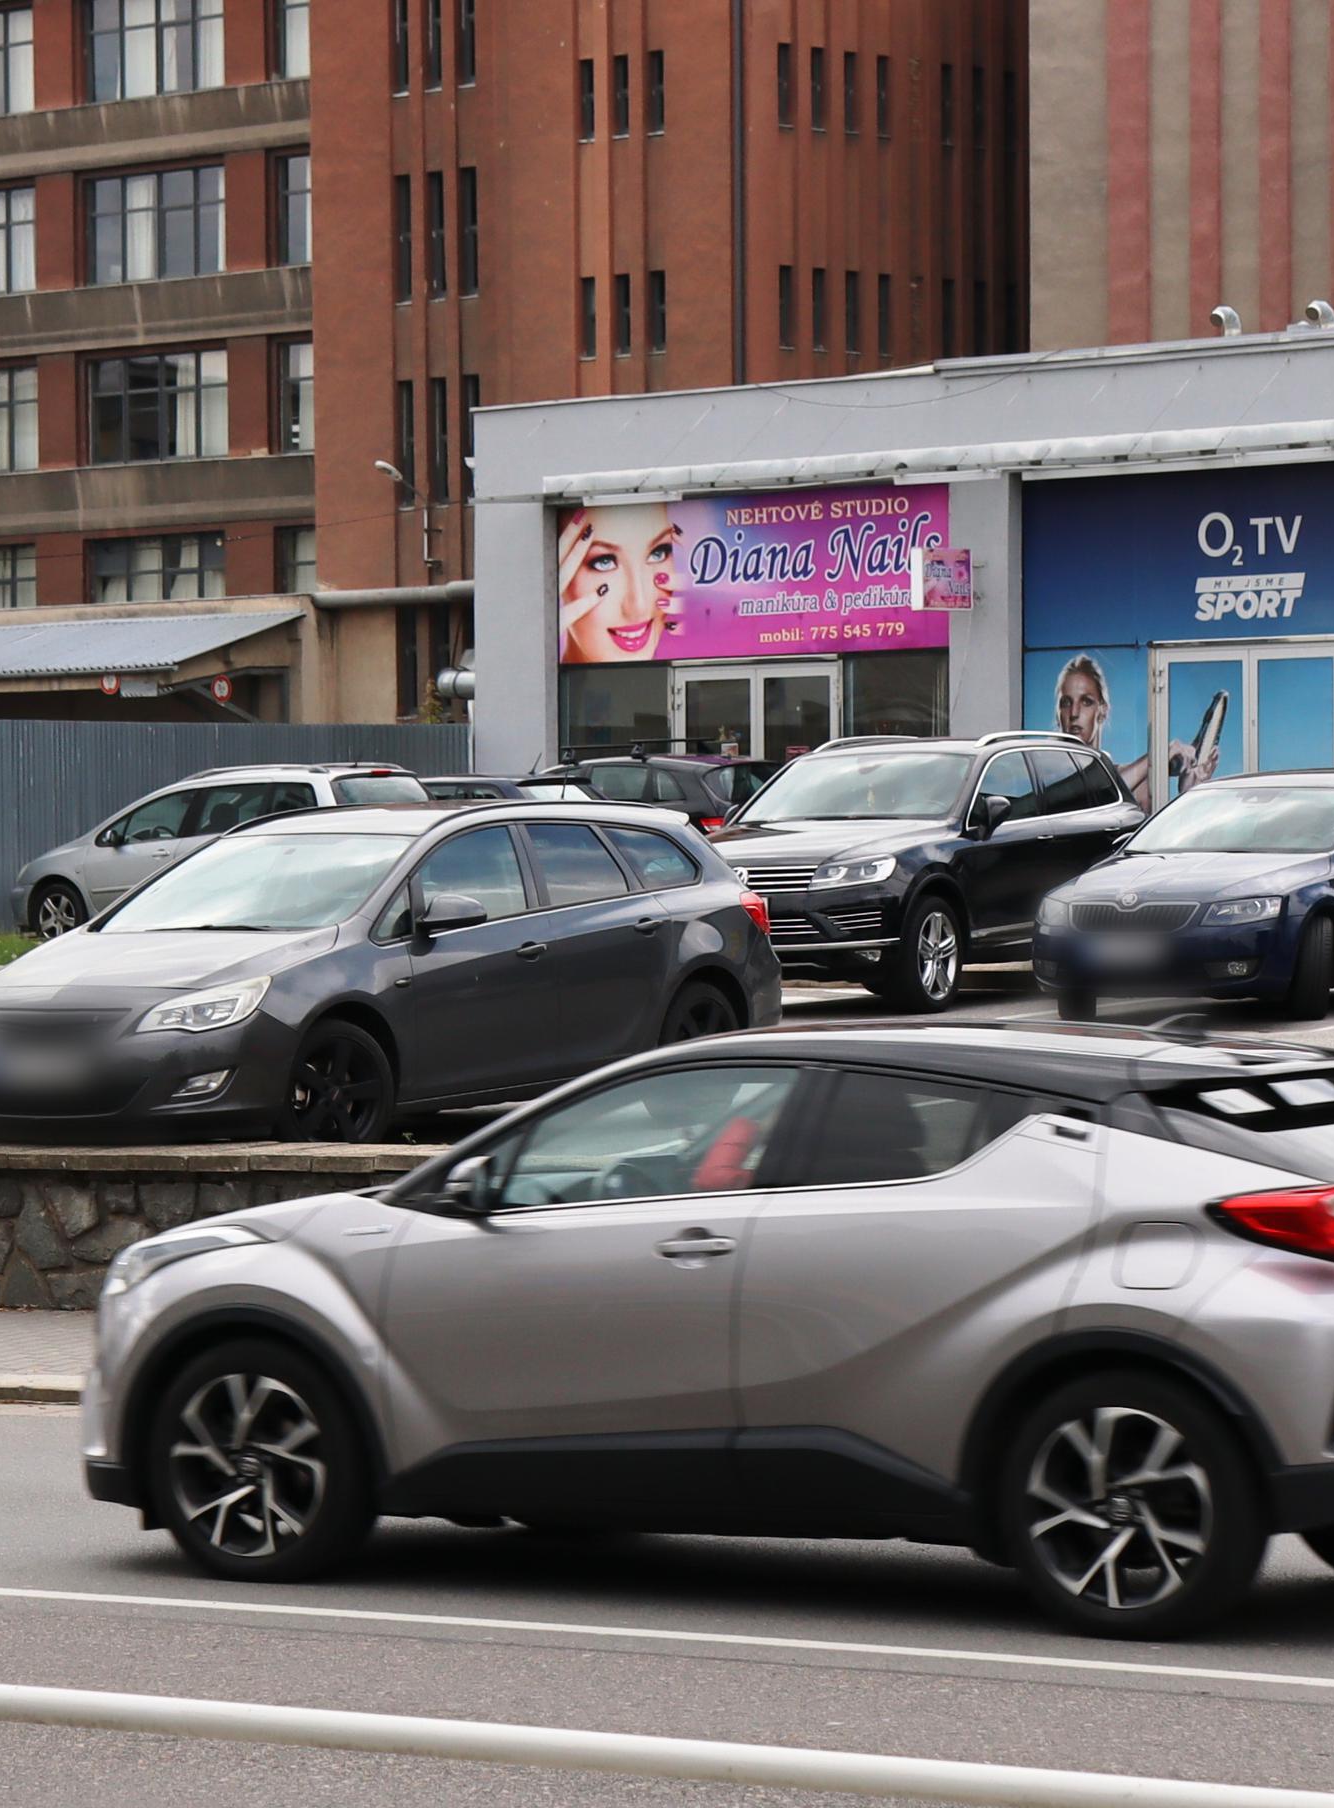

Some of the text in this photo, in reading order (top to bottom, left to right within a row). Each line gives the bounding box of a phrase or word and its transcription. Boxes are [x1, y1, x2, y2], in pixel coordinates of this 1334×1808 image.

[726, 497, 909, 527] NEHTOVÉ STUDIO
[1249, 515, 1303, 555] TV
[690, 529, 816, 587] Diana
[1214, 577, 1285, 589] MY JSME
[739, 584, 911, 618] manikúra & pedikúr
[1194, 589, 1303, 622] SPORT
[759, 621, 905, 643] mobil: 775 545 779
